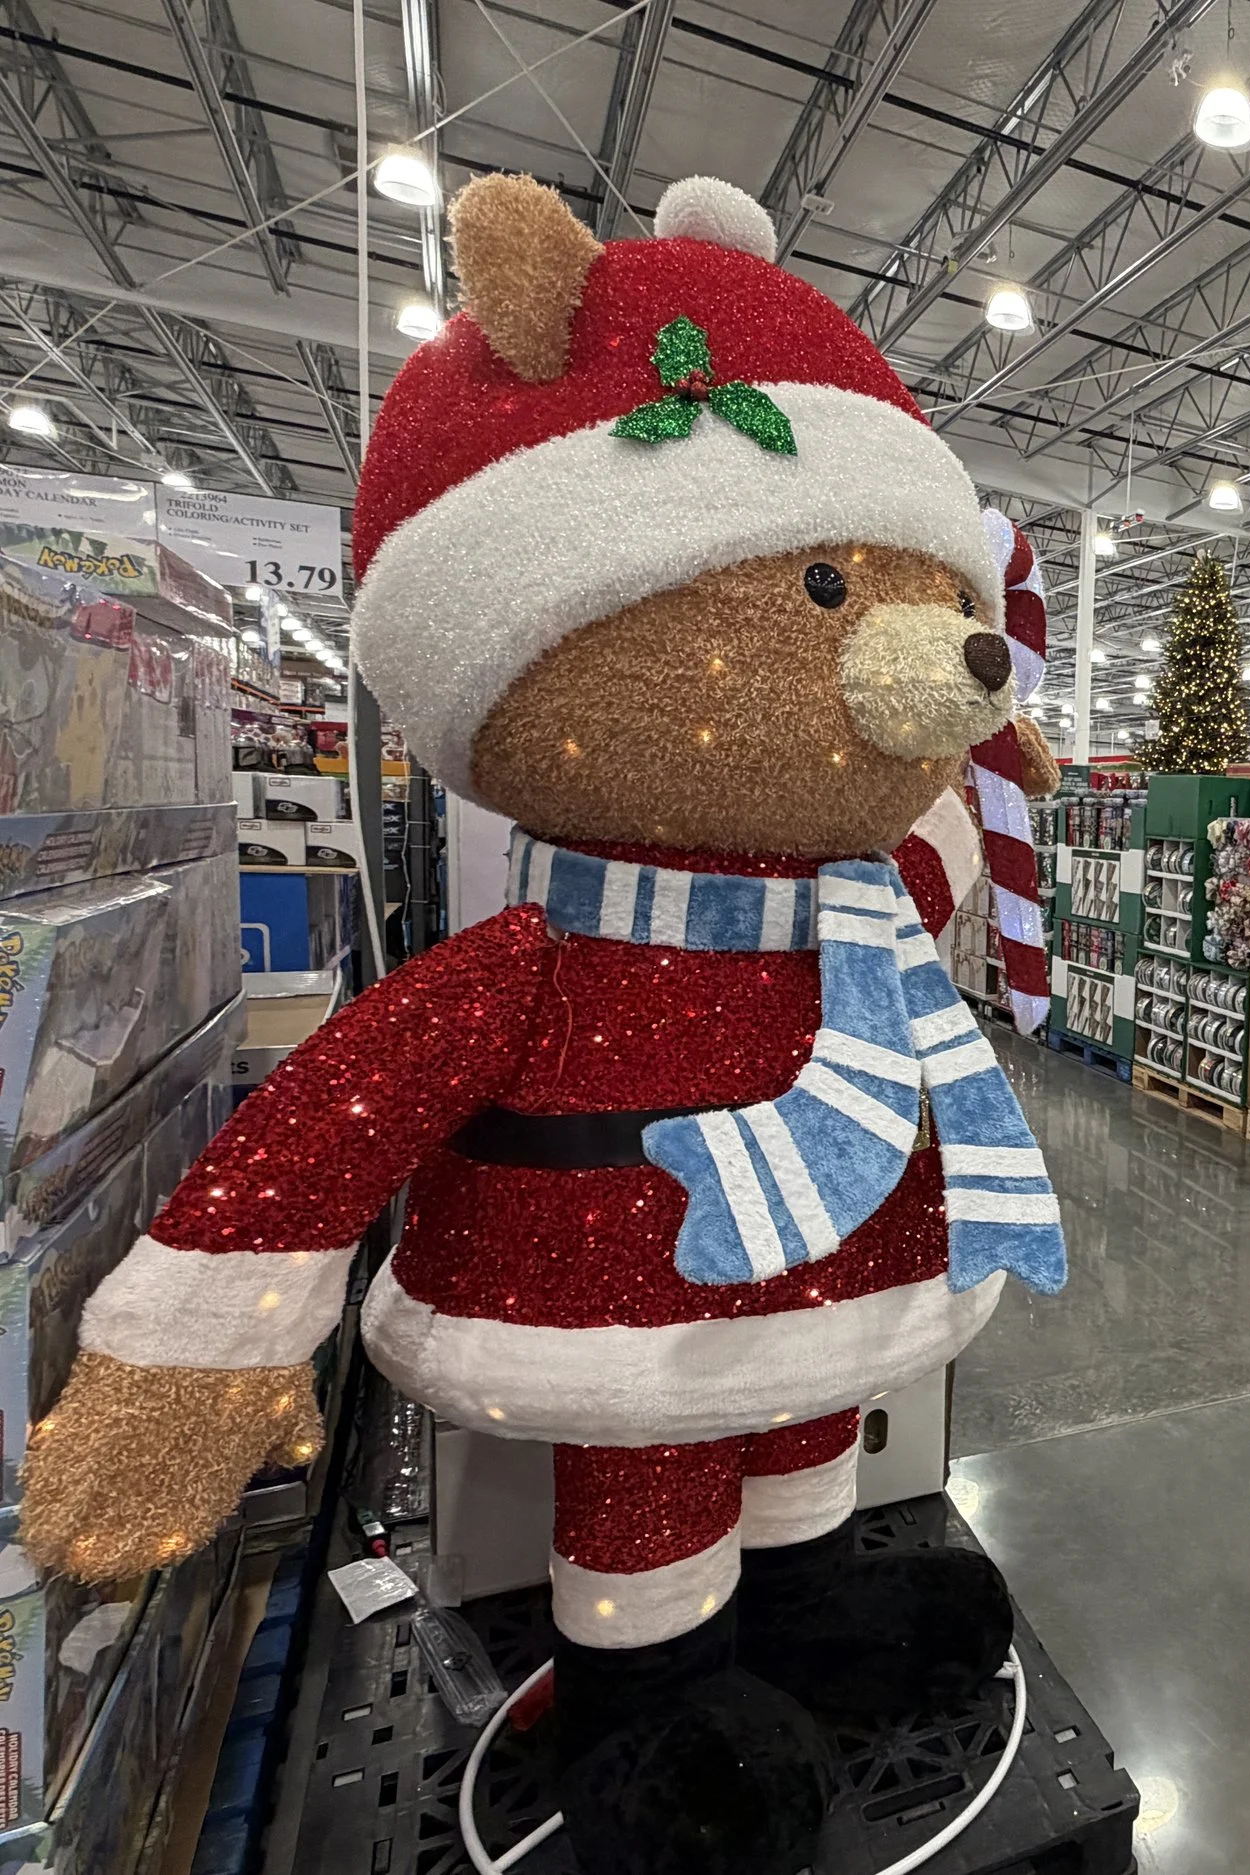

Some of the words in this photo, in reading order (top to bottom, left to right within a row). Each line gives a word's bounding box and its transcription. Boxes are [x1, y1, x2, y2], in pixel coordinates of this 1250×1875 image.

[25, 490, 98, 507] CALENDAR
[167, 498, 219, 513] TRIFOLD
[166, 508, 287, 531] COLORING/ACTIVITY
[289, 522, 311, 534] SET
[245, 559, 337, 591] 13.79
[8, 1733, 19, 1772] HOLIDAY
